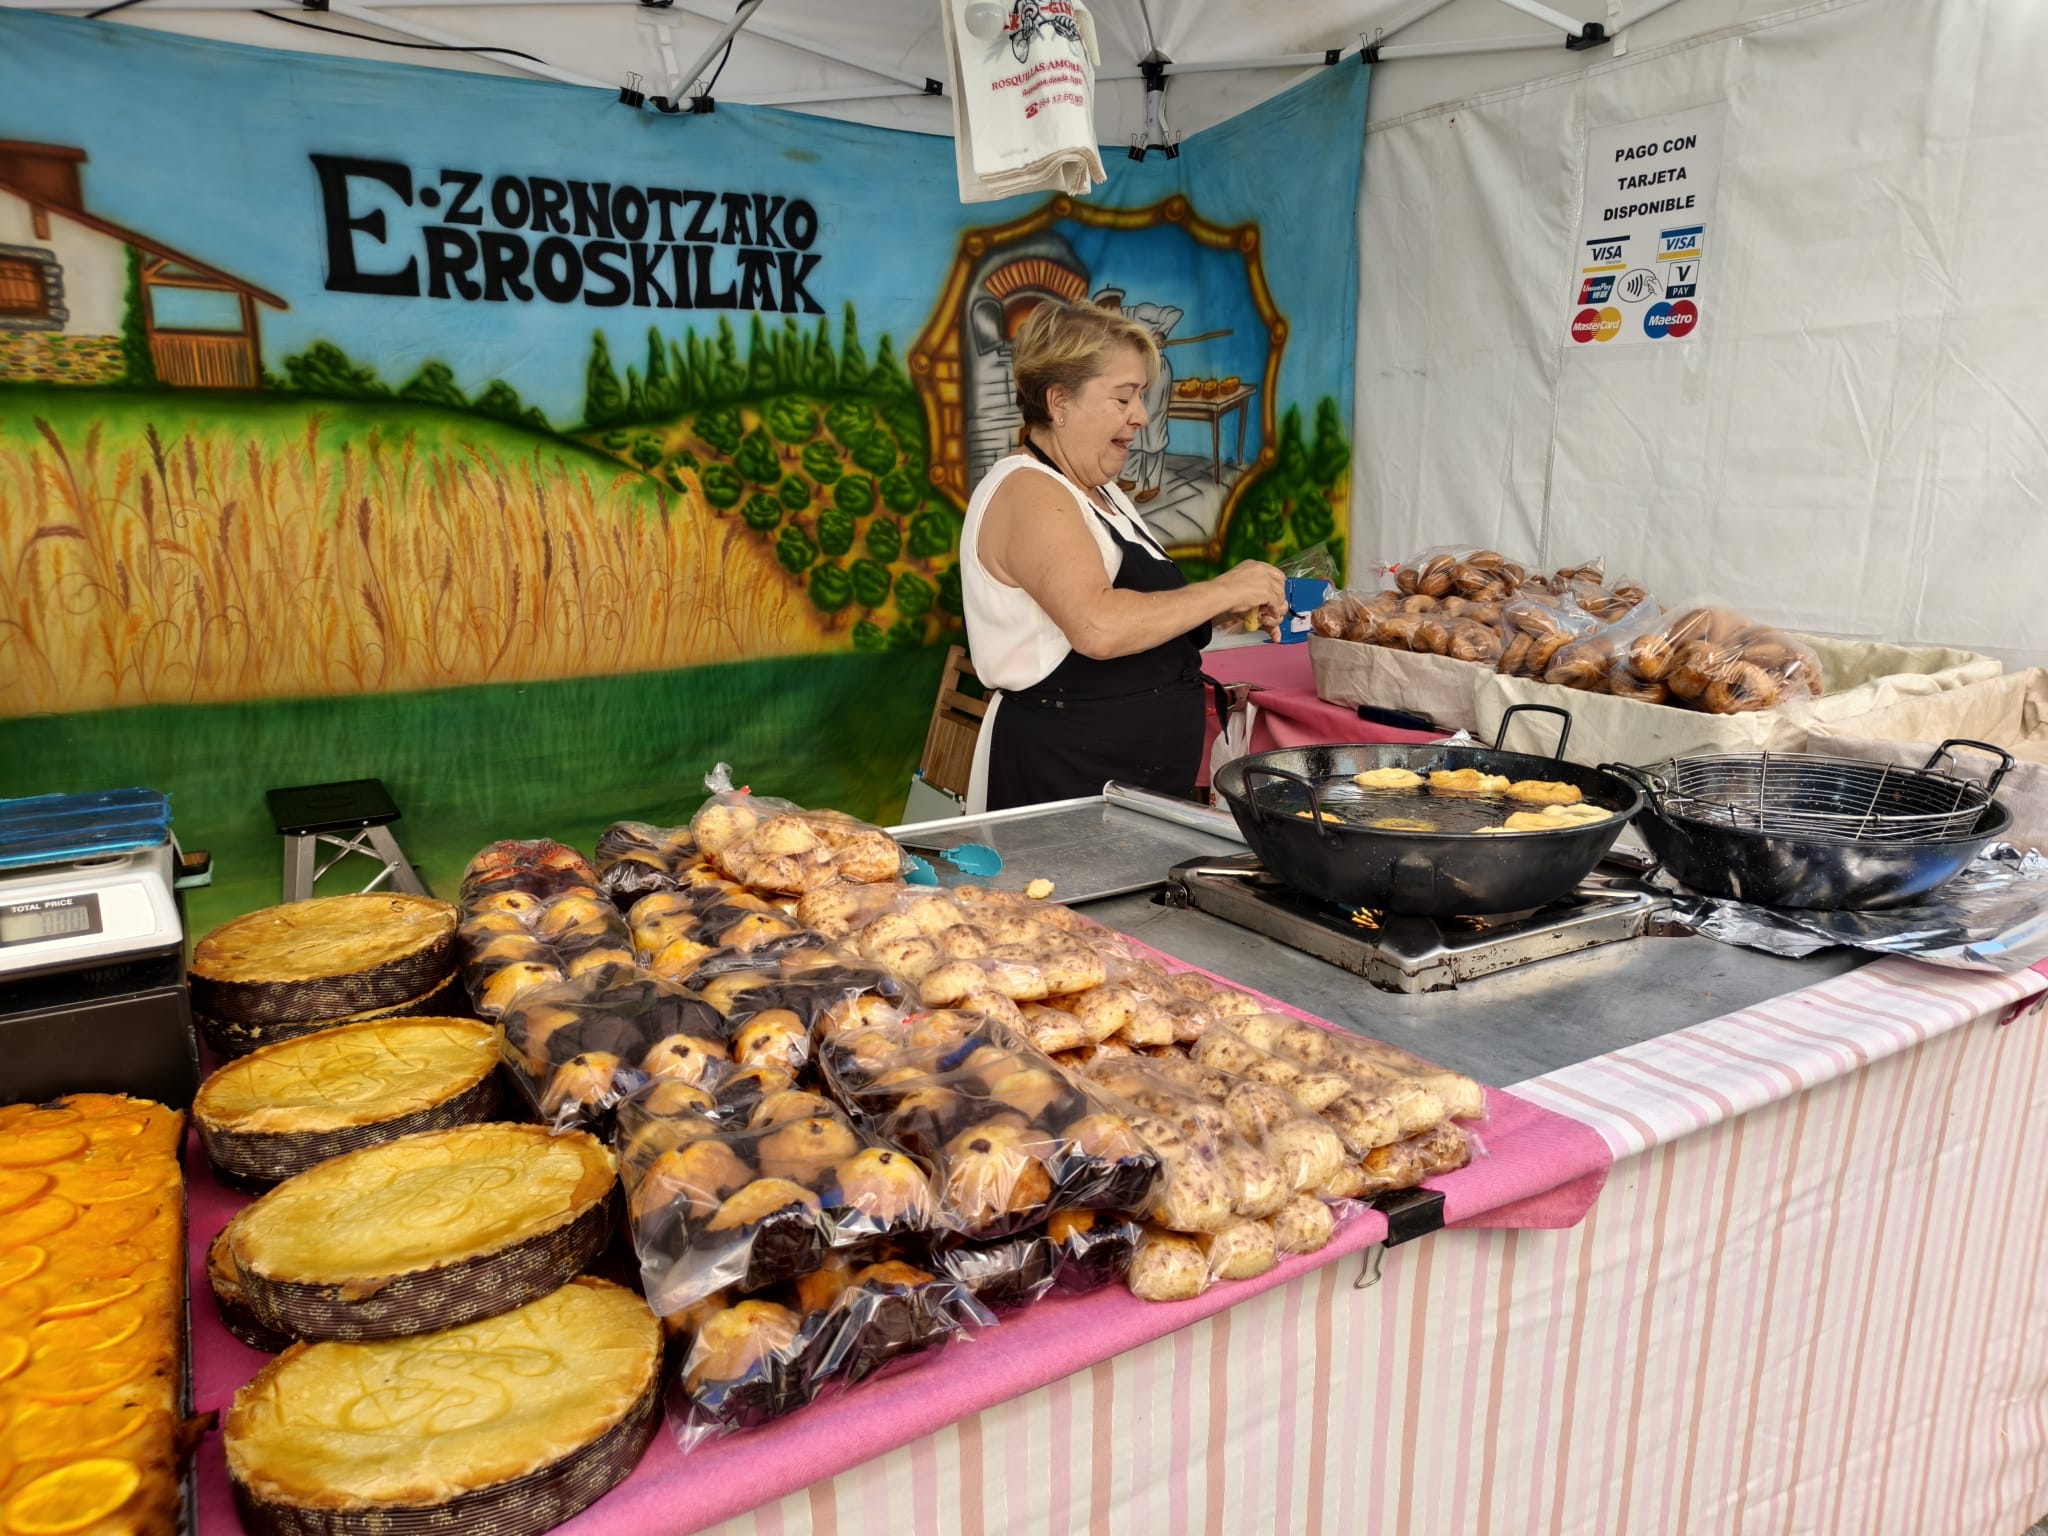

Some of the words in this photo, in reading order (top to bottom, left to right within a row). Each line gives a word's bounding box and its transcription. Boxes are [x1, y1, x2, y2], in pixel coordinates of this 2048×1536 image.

[991, 62, 1045, 91] ROSQUILLAS
[1615, 143, 1658, 162] PAGO
[1663, 135, 1697, 153] CON
[1618, 167, 1687, 191] TARJETA
[1603, 195, 1695, 221] DISPONIBLE
[1665, 236, 1696, 251] VISA
[1591, 245, 1622, 261] VISA
[1675, 265, 1691, 282] V
[1672, 286, 1689, 296] PAY
[1573, 320, 1620, 331] MasterCard
[1648, 314, 1692, 326] Maestro
[11, 903, 41, 913] TOTAL
[44, 898, 73, 908] PRICE
